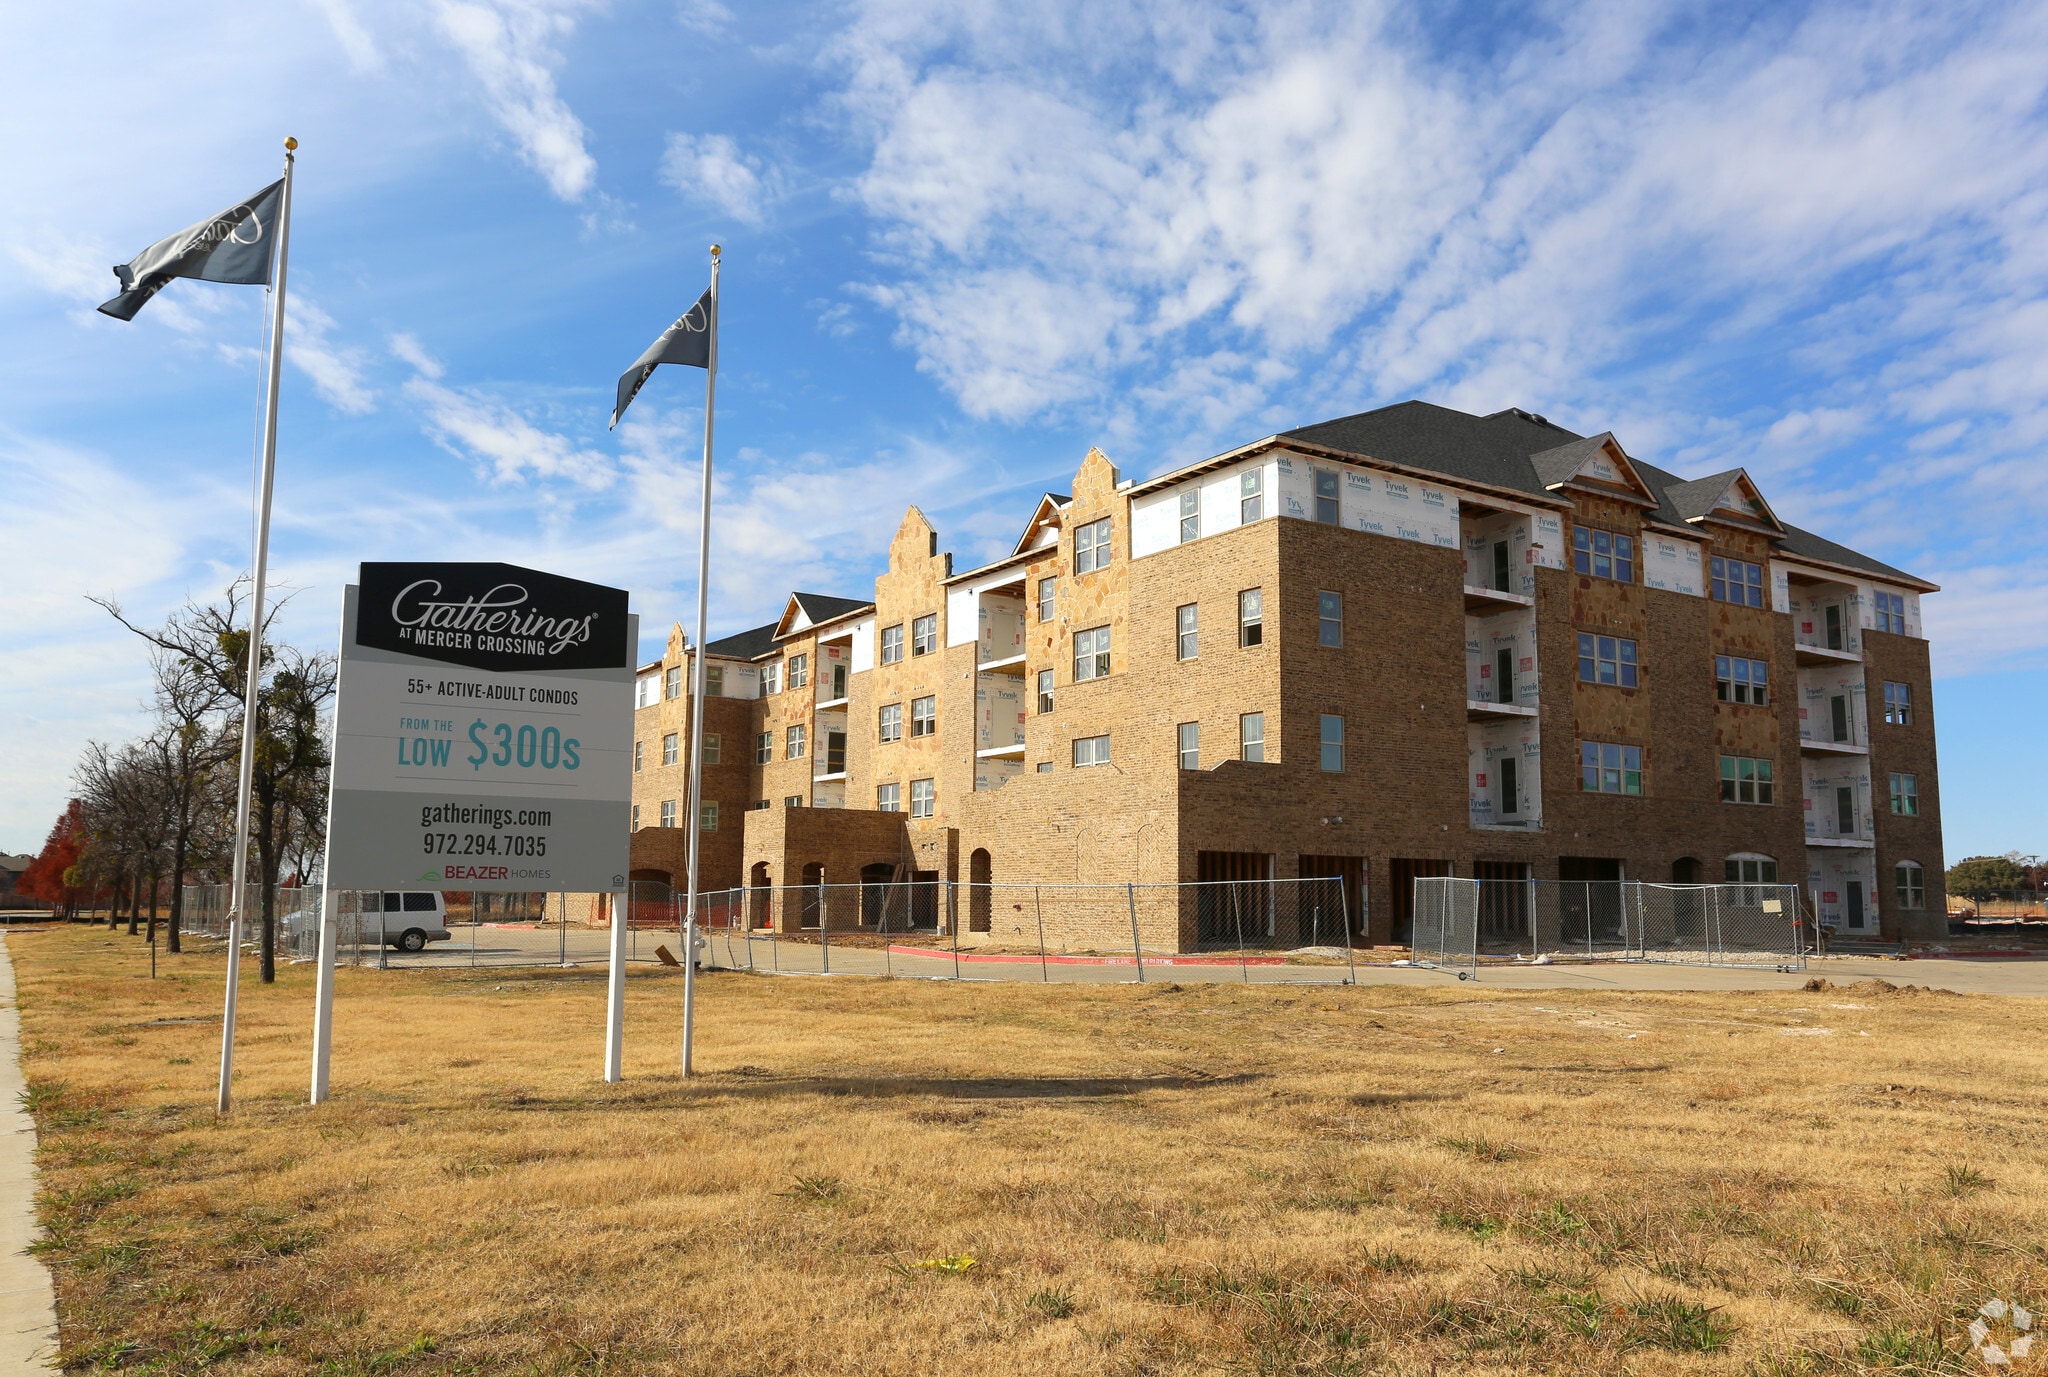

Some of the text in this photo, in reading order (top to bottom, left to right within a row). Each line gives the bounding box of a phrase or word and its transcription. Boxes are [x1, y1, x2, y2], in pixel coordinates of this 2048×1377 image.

[1592, 461, 1611, 473] Tyvek
[1346, 471, 1371, 485] Tyvek
[1385, 480, 1408, 493] Tyvek
[1421, 488, 1444, 501] Tyvek
[1359, 518, 1383, 531] Tyvek
[1538, 517, 1557, 527] Tyvek
[1397, 526, 1420, 539] Tyvek
[1657, 541, 1676, 552] Tyvek
[1647, 577, 1665, 587] Tyvek
[1675, 583, 1693, 593] Tyvek
[392, 579, 592, 655] Gatherings
[400, 627, 545, 656] AT MERCER CROSSING
[407, 679, 578, 705] 55+ ACTIVE-ADULT CONDOS
[400, 718, 453, 732] FROM THE
[398, 718, 581, 771] LOW $300s
[1470, 799, 1491, 808] Tyvek
[421, 803, 552, 829] gatherings.com
[424, 833, 546, 856] 972.294.7035
[445, 865, 551, 880] BEAZER HOMES
